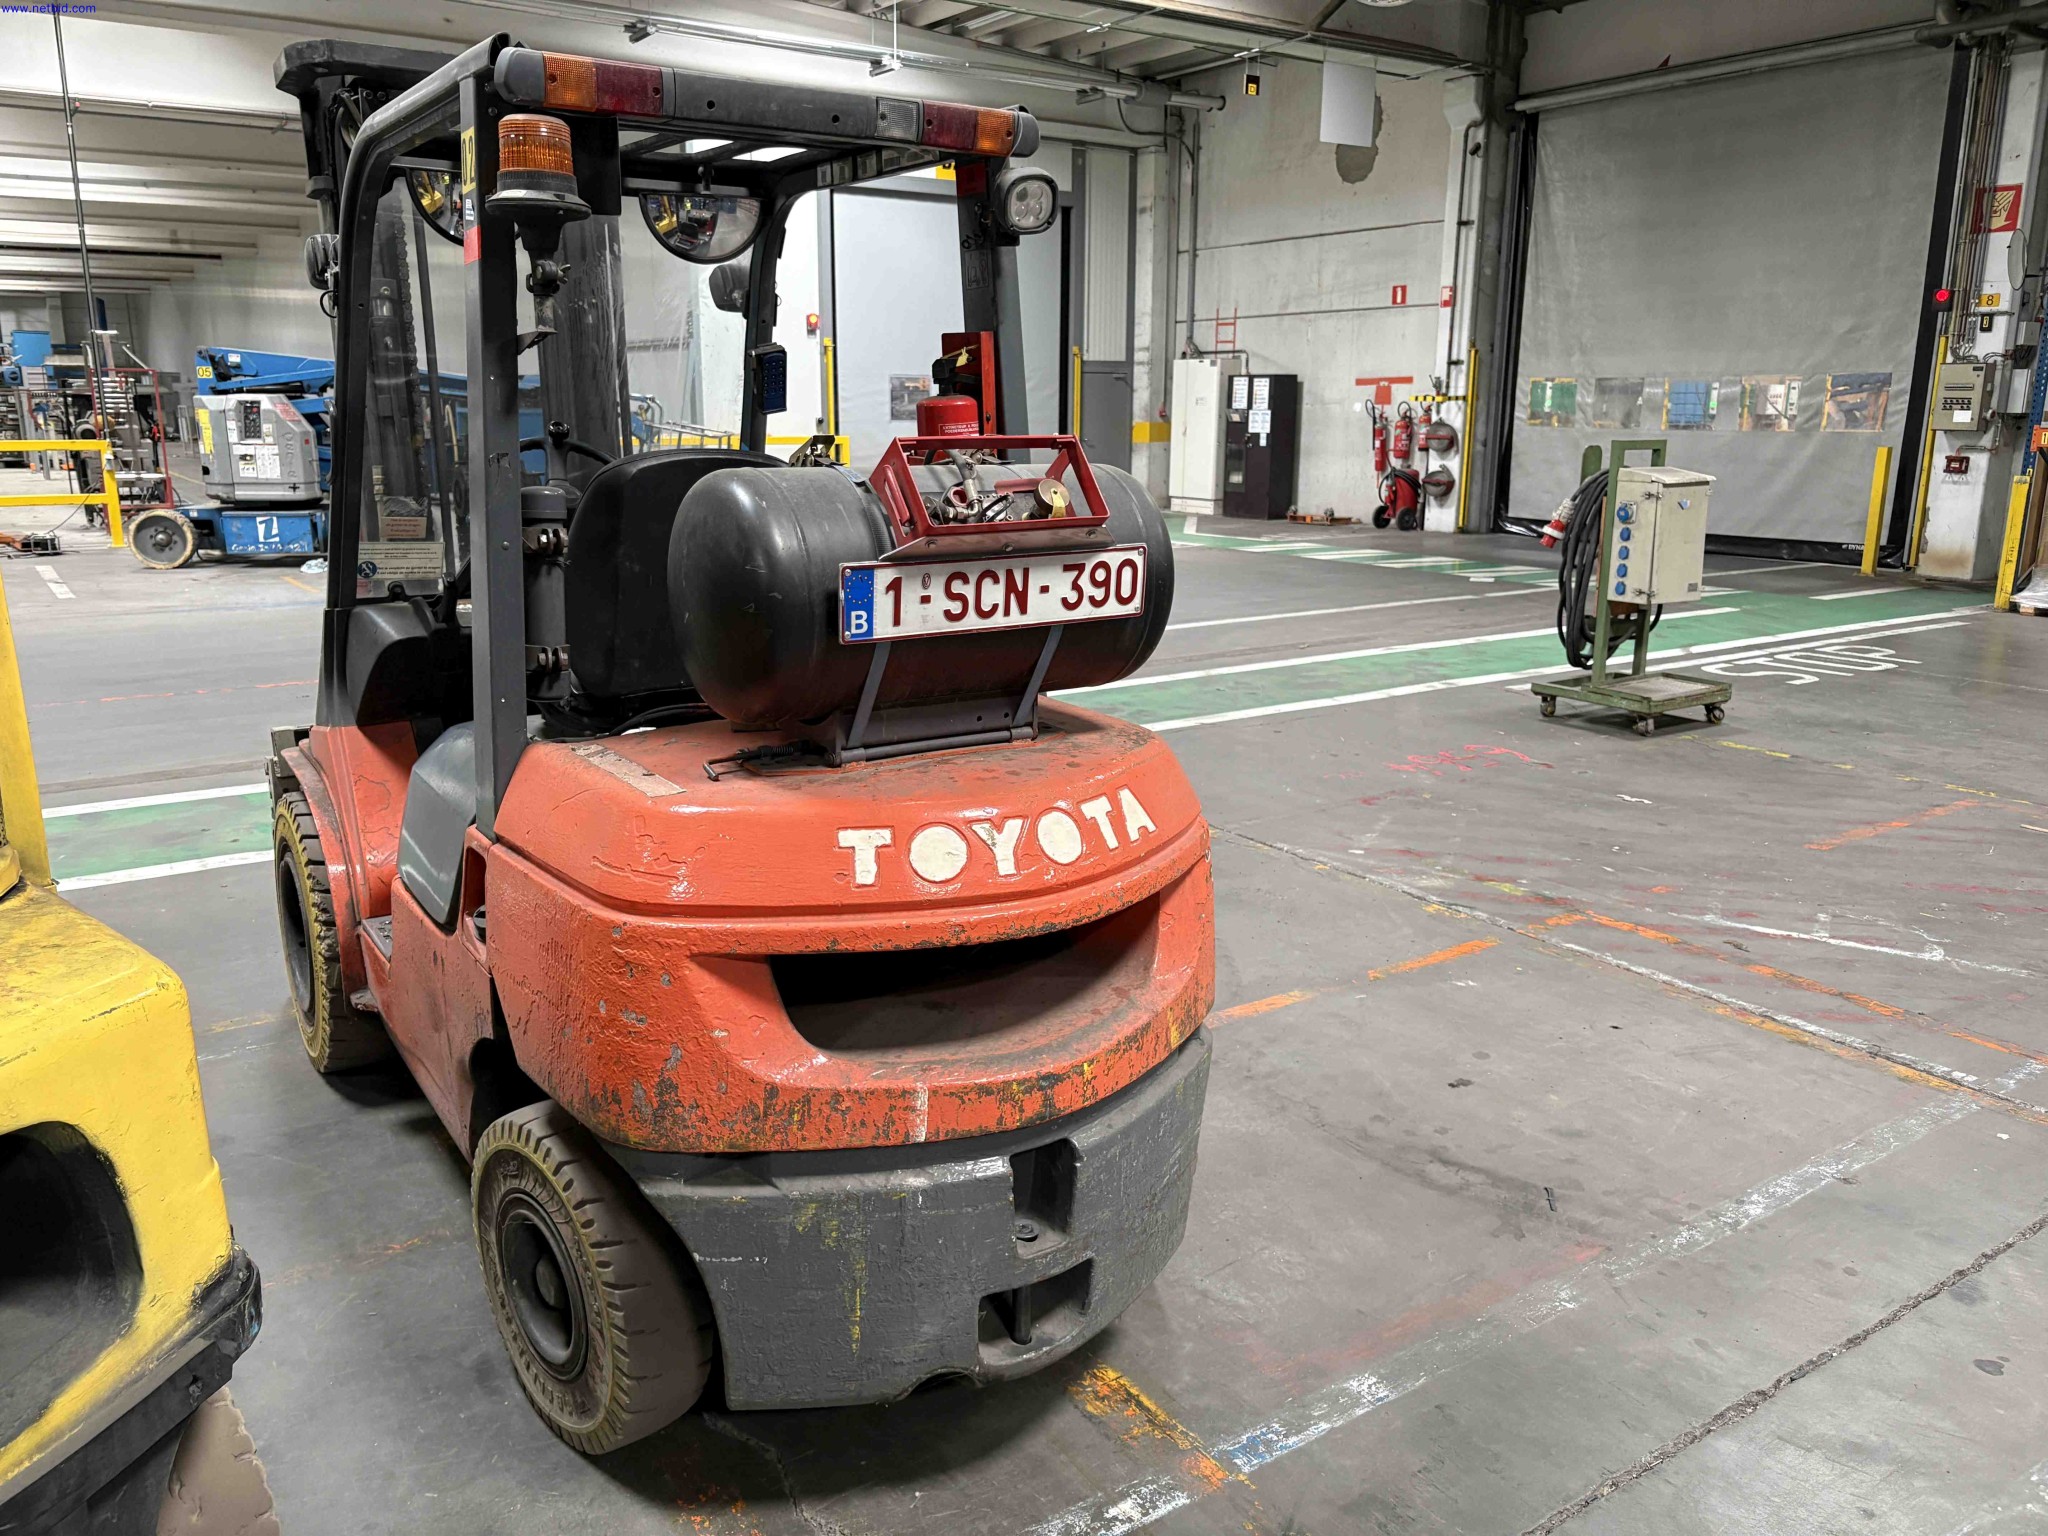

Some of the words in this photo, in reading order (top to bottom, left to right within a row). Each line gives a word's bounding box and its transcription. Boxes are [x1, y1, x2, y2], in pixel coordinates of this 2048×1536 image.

[1986, 294, 1994, 306] 8
[197, 368, 213, 378] 05
[850, 609, 869, 635] B
[1700, 645, 1923, 685] STOP
[836, 787, 1158, 886] TOYOTA
